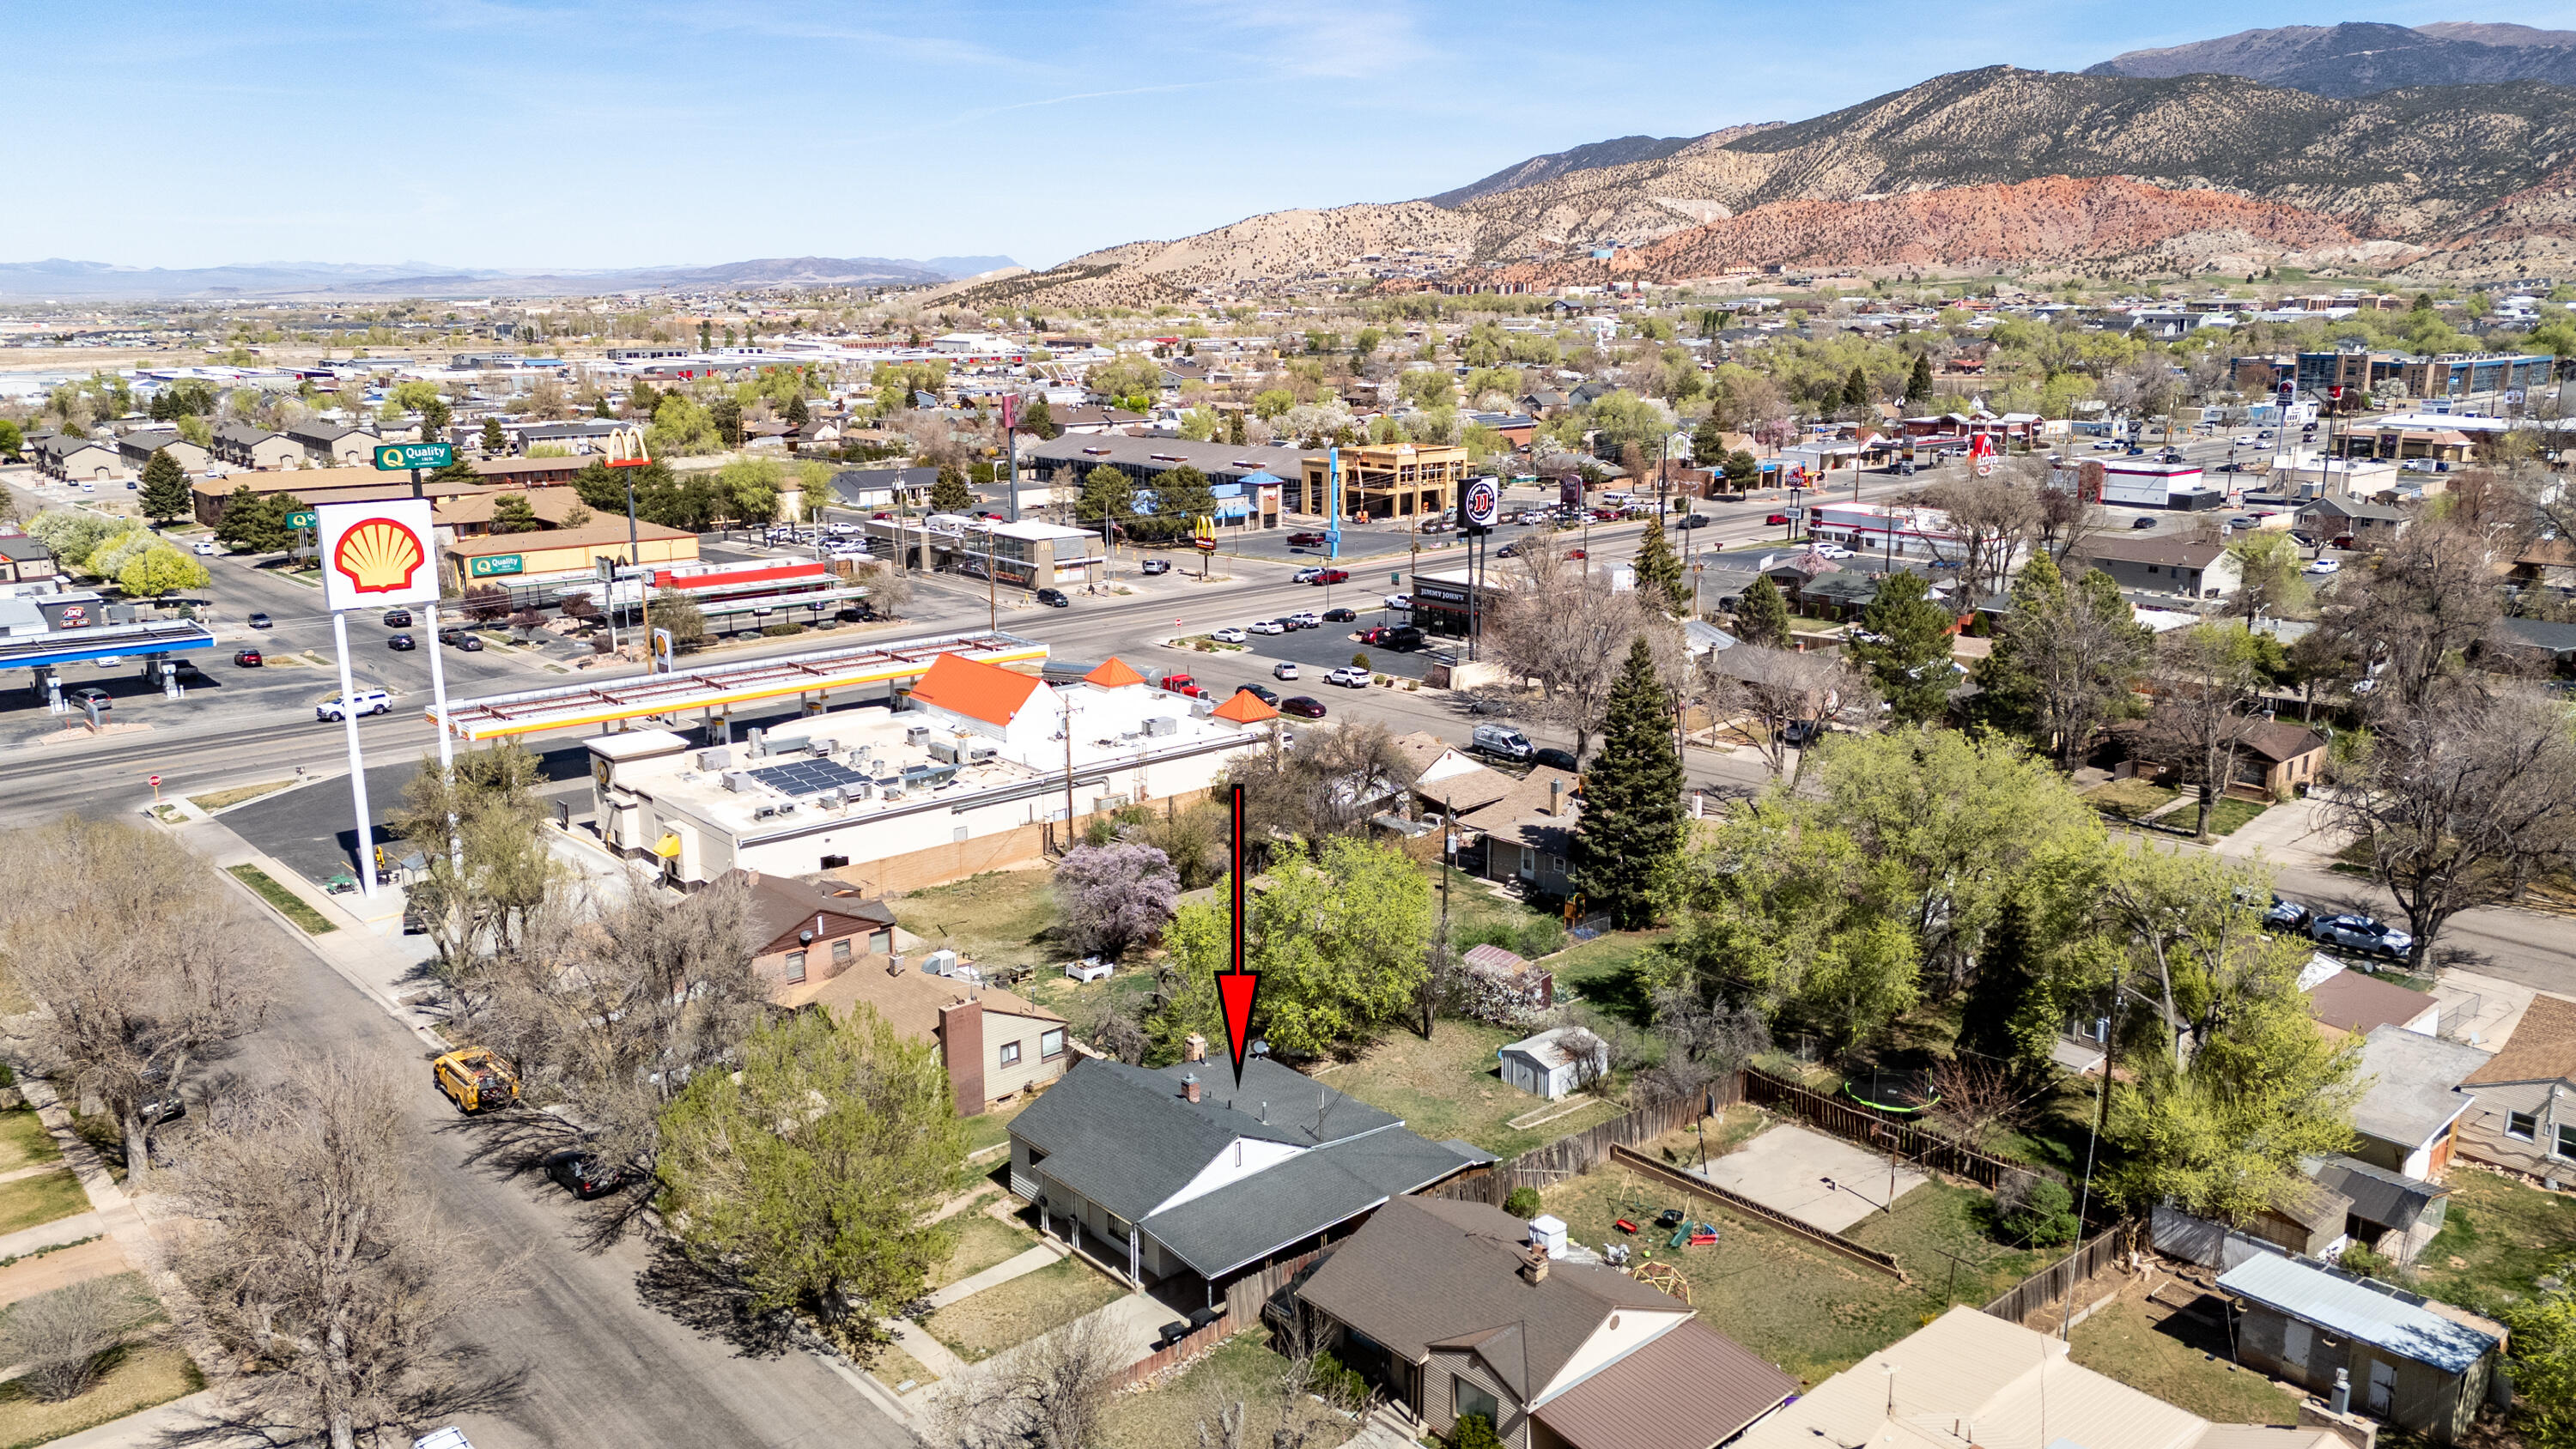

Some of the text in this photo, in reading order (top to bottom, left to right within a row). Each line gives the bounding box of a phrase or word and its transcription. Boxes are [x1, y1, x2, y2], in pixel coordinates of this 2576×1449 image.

[405, 446, 446, 458] Quality
[1474, 493, 1489, 512] JJ
[491, 557, 518, 567] Quality
[1420, 588, 1464, 601] JIMMY JOHN'S
[67, 609, 82, 617] DQ
